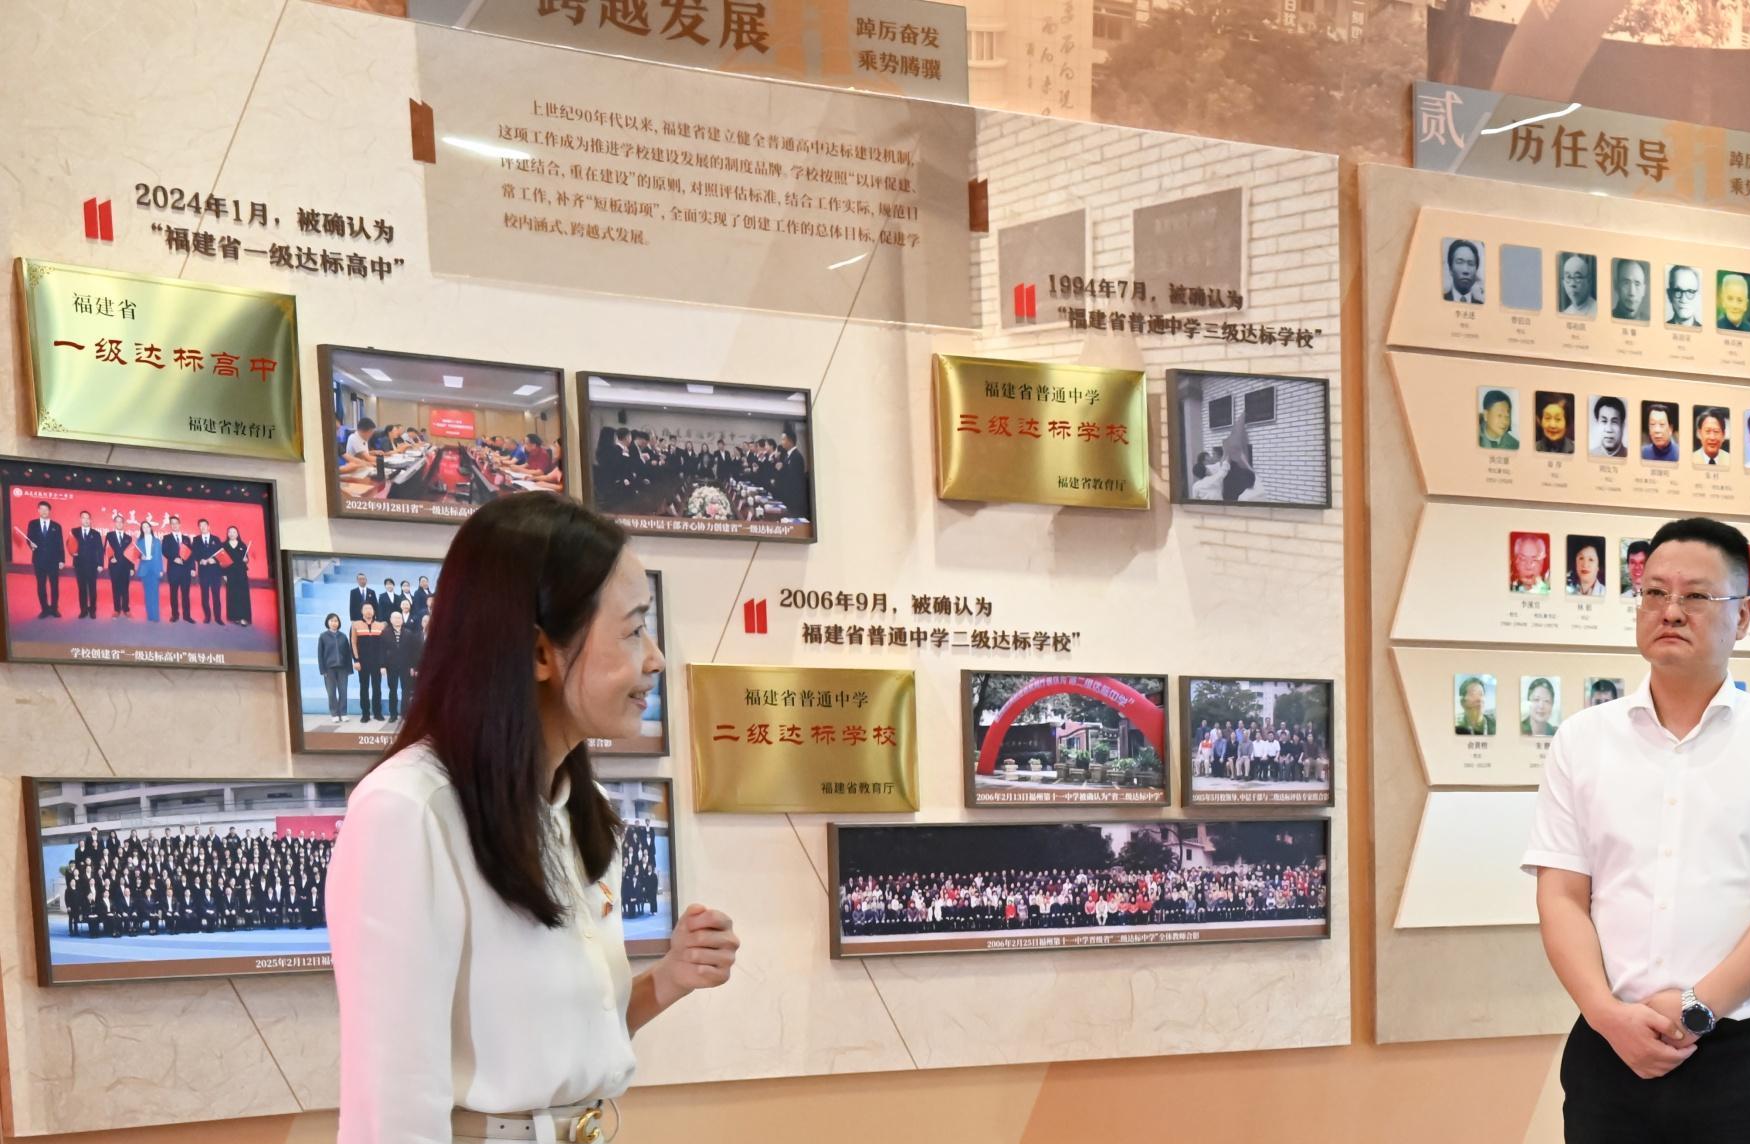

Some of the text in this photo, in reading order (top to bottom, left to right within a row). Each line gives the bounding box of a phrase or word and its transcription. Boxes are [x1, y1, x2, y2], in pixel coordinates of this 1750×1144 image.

[855, 16, 941, 49] 踔厉奋发
[856, 49, 942, 82] 乘势腾骥
[1506, 122, 1672, 184] 历任领导
[72, 291, 137, 321] 福建省
[53, 336, 278, 383] 一级达标高中
[984, 380, 1101, 406] 福建省普通中学
[187, 415, 277, 440] 福建省教育厅
[957, 413, 1130, 446] 三级达标学校
[1057, 475, 1127, 494] 福建省教育厅
[778, 587, 993, 618] 2006年9月，被确认为
[744, 688, 869, 708] 福建省普通中学
[712, 723, 899, 748] 二级达标学校
[820, 780, 896, 796] 福建省教育厅
